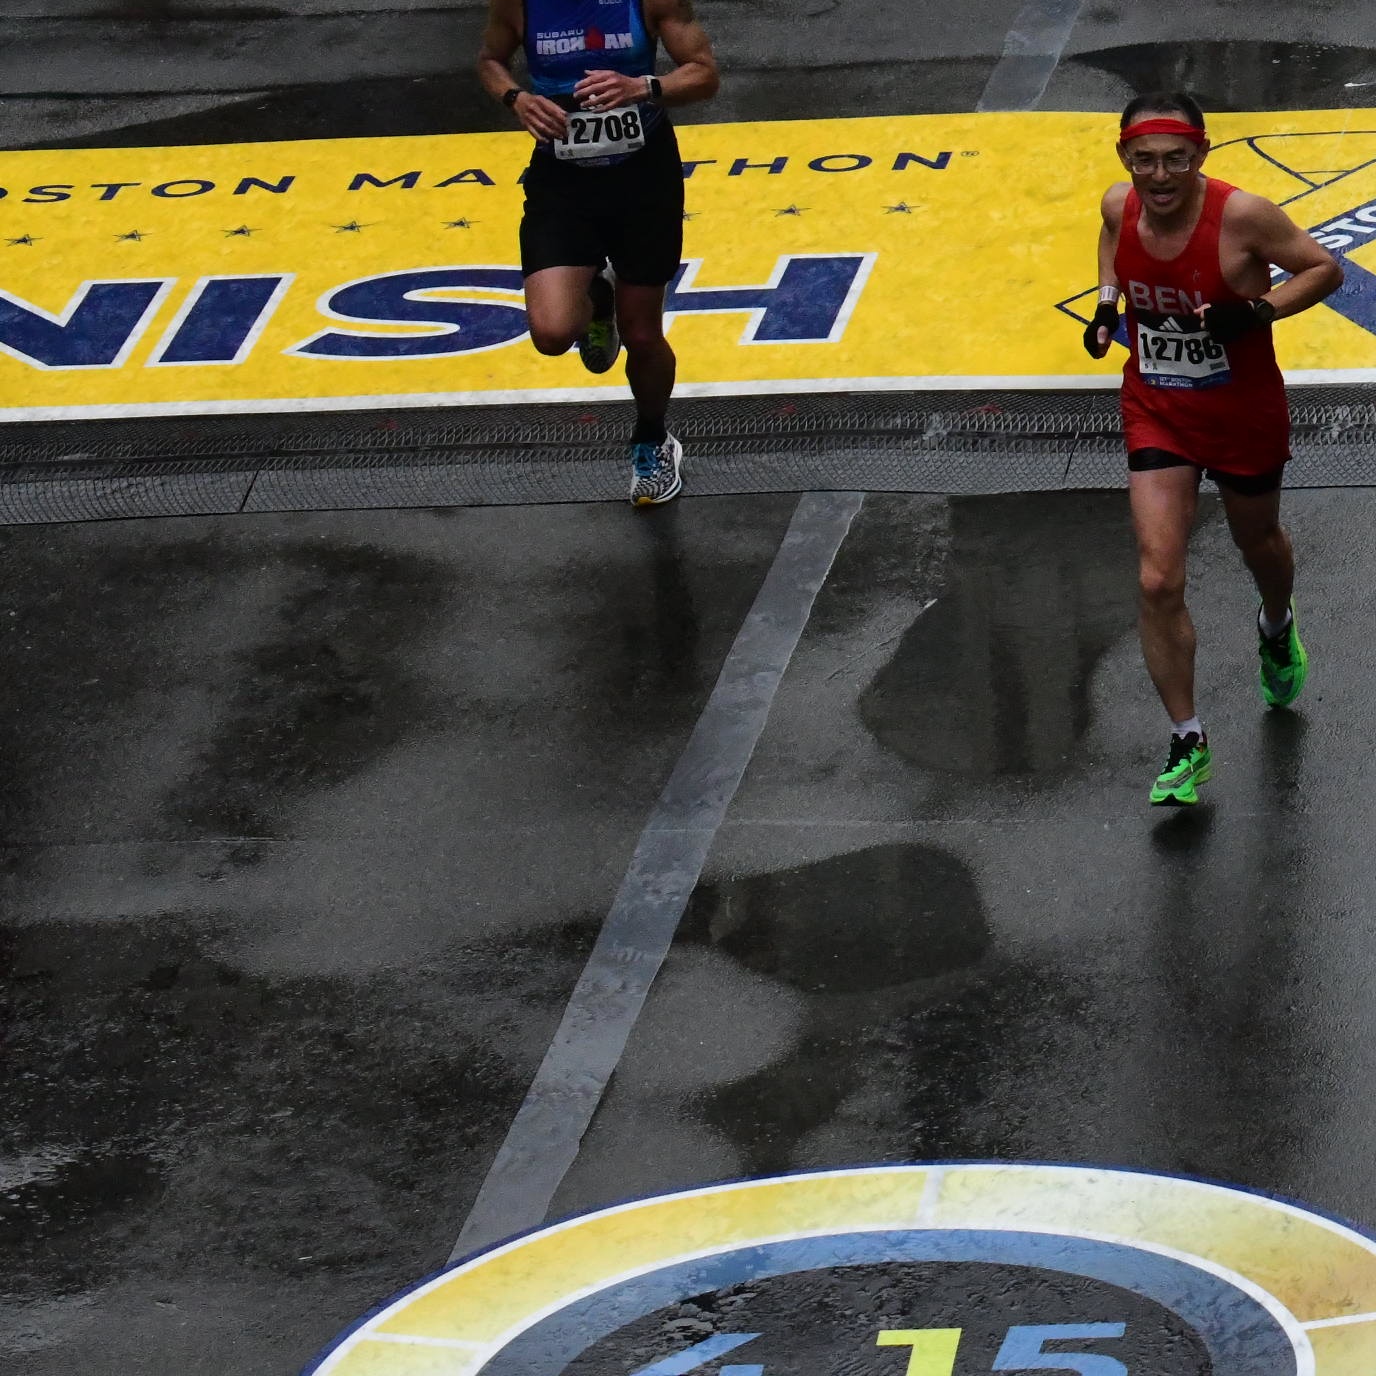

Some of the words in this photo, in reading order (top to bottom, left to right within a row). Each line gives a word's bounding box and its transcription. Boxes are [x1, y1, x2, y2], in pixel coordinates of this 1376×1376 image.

[536, 28, 584, 39] SUBARU
[0, 175, 296, 204] STON
[346, 150, 956, 190] MATHON
